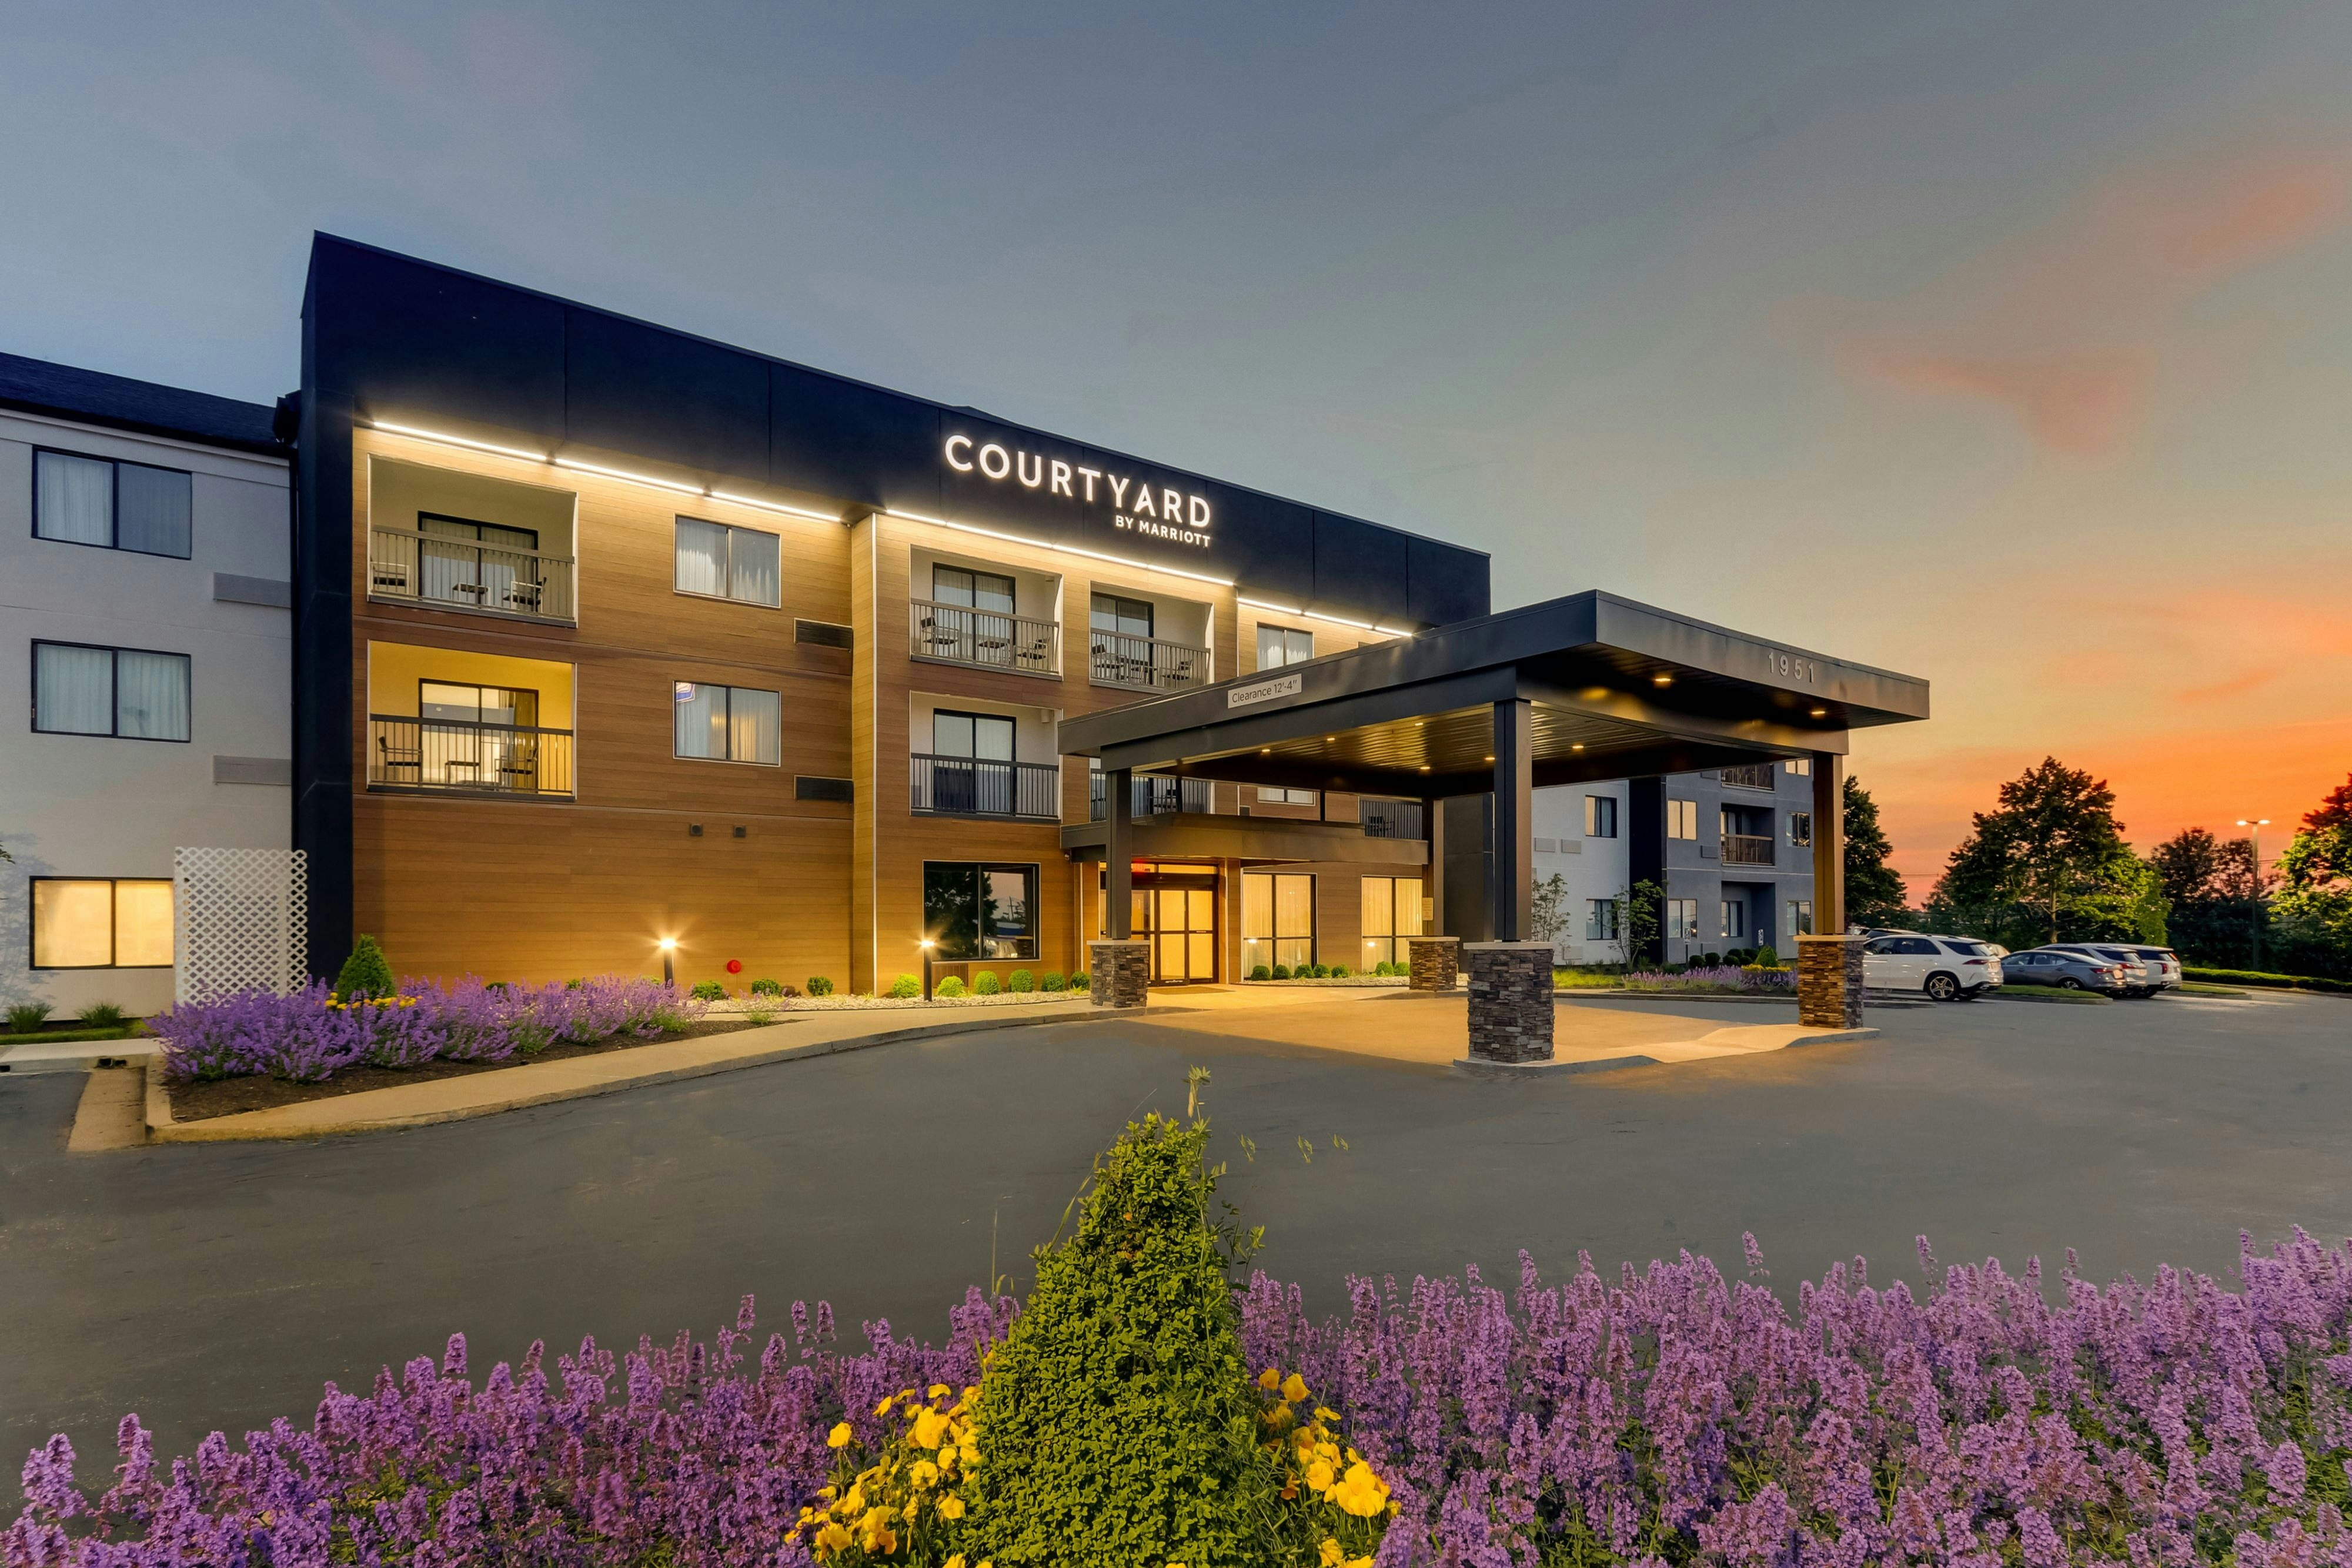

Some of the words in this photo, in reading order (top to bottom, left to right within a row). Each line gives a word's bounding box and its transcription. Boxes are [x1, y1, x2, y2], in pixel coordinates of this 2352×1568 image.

[944, 434, 1211, 527] COURTYARD
[1115, 515, 1134, 529] BY
[1139, 522, 1211, 547] MARRIOTT
[1768, 651, 1815, 683] 1951
[1232, 687, 1272, 703] Clearance
